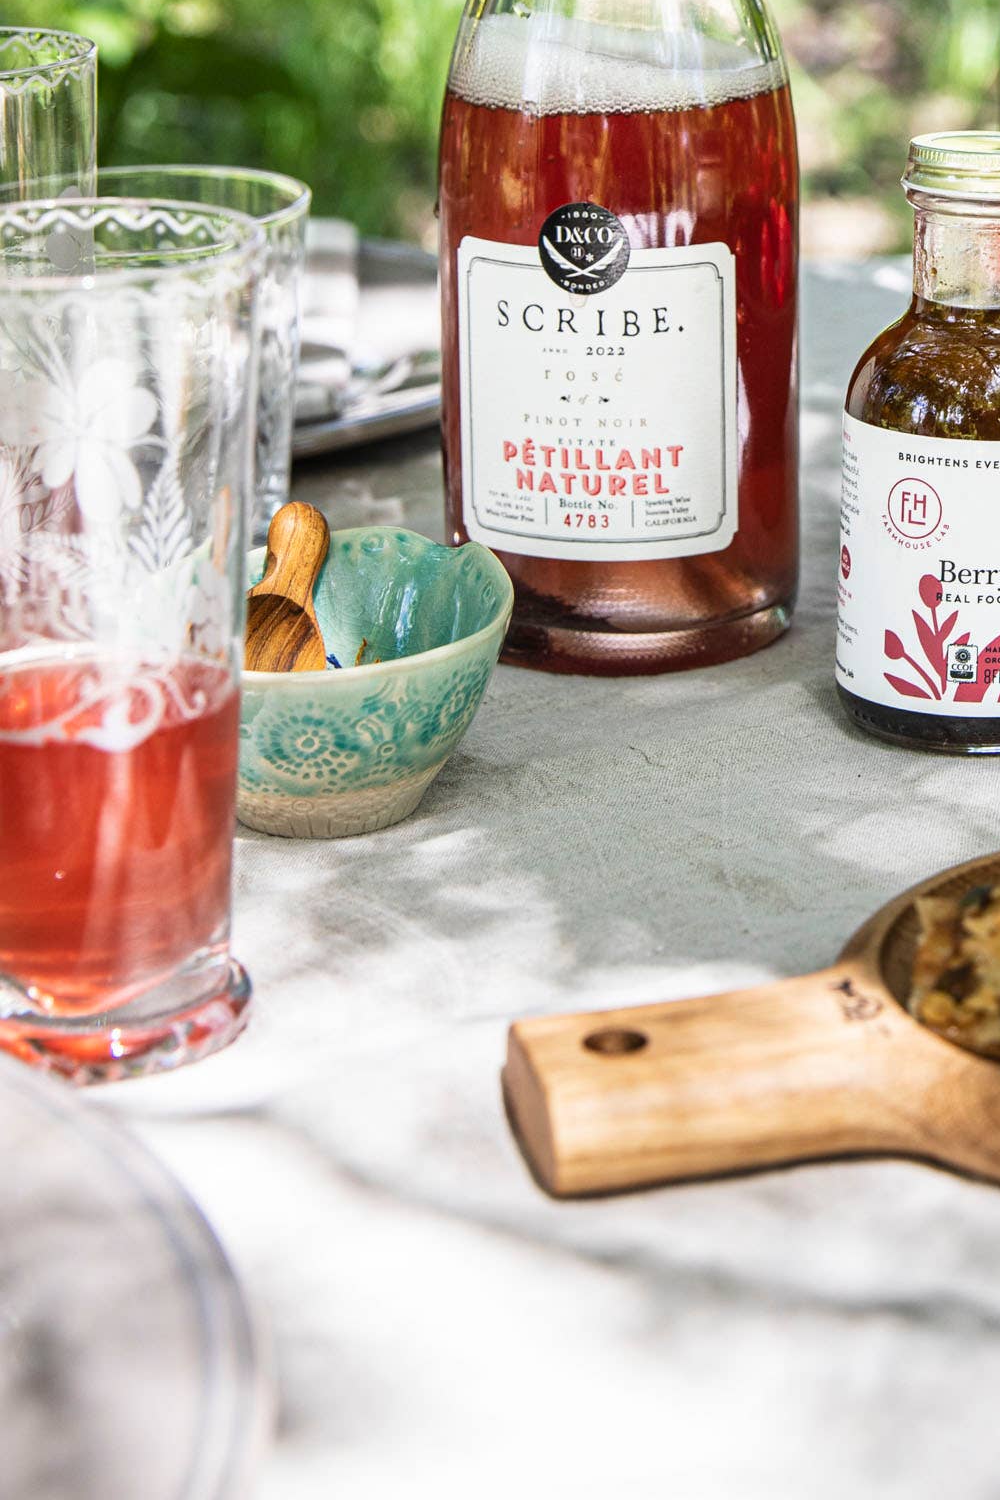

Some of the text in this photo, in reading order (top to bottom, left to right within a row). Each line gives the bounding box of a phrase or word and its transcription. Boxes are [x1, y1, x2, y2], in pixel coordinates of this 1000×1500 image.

[555, 226, 613, 244] D&CO
[498, 300, 685, 337] SCRIBE.
[586, 346, 625, 356] 2022
[523, 413, 648, 428] PINOT NOIR
[503, 438, 684, 471] PÉTILLANT
[898, 452, 969, 468] BRIGHTENS
[516, 468, 670, 496] NATUREL
[559, 498, 619, 511] Bottle No.
[563, 513, 610, 529] 4783
[934, 524, 950, 542] LAB
[936, 593, 970, 603] REAL
[951, 663, 973, 671] CCOF
